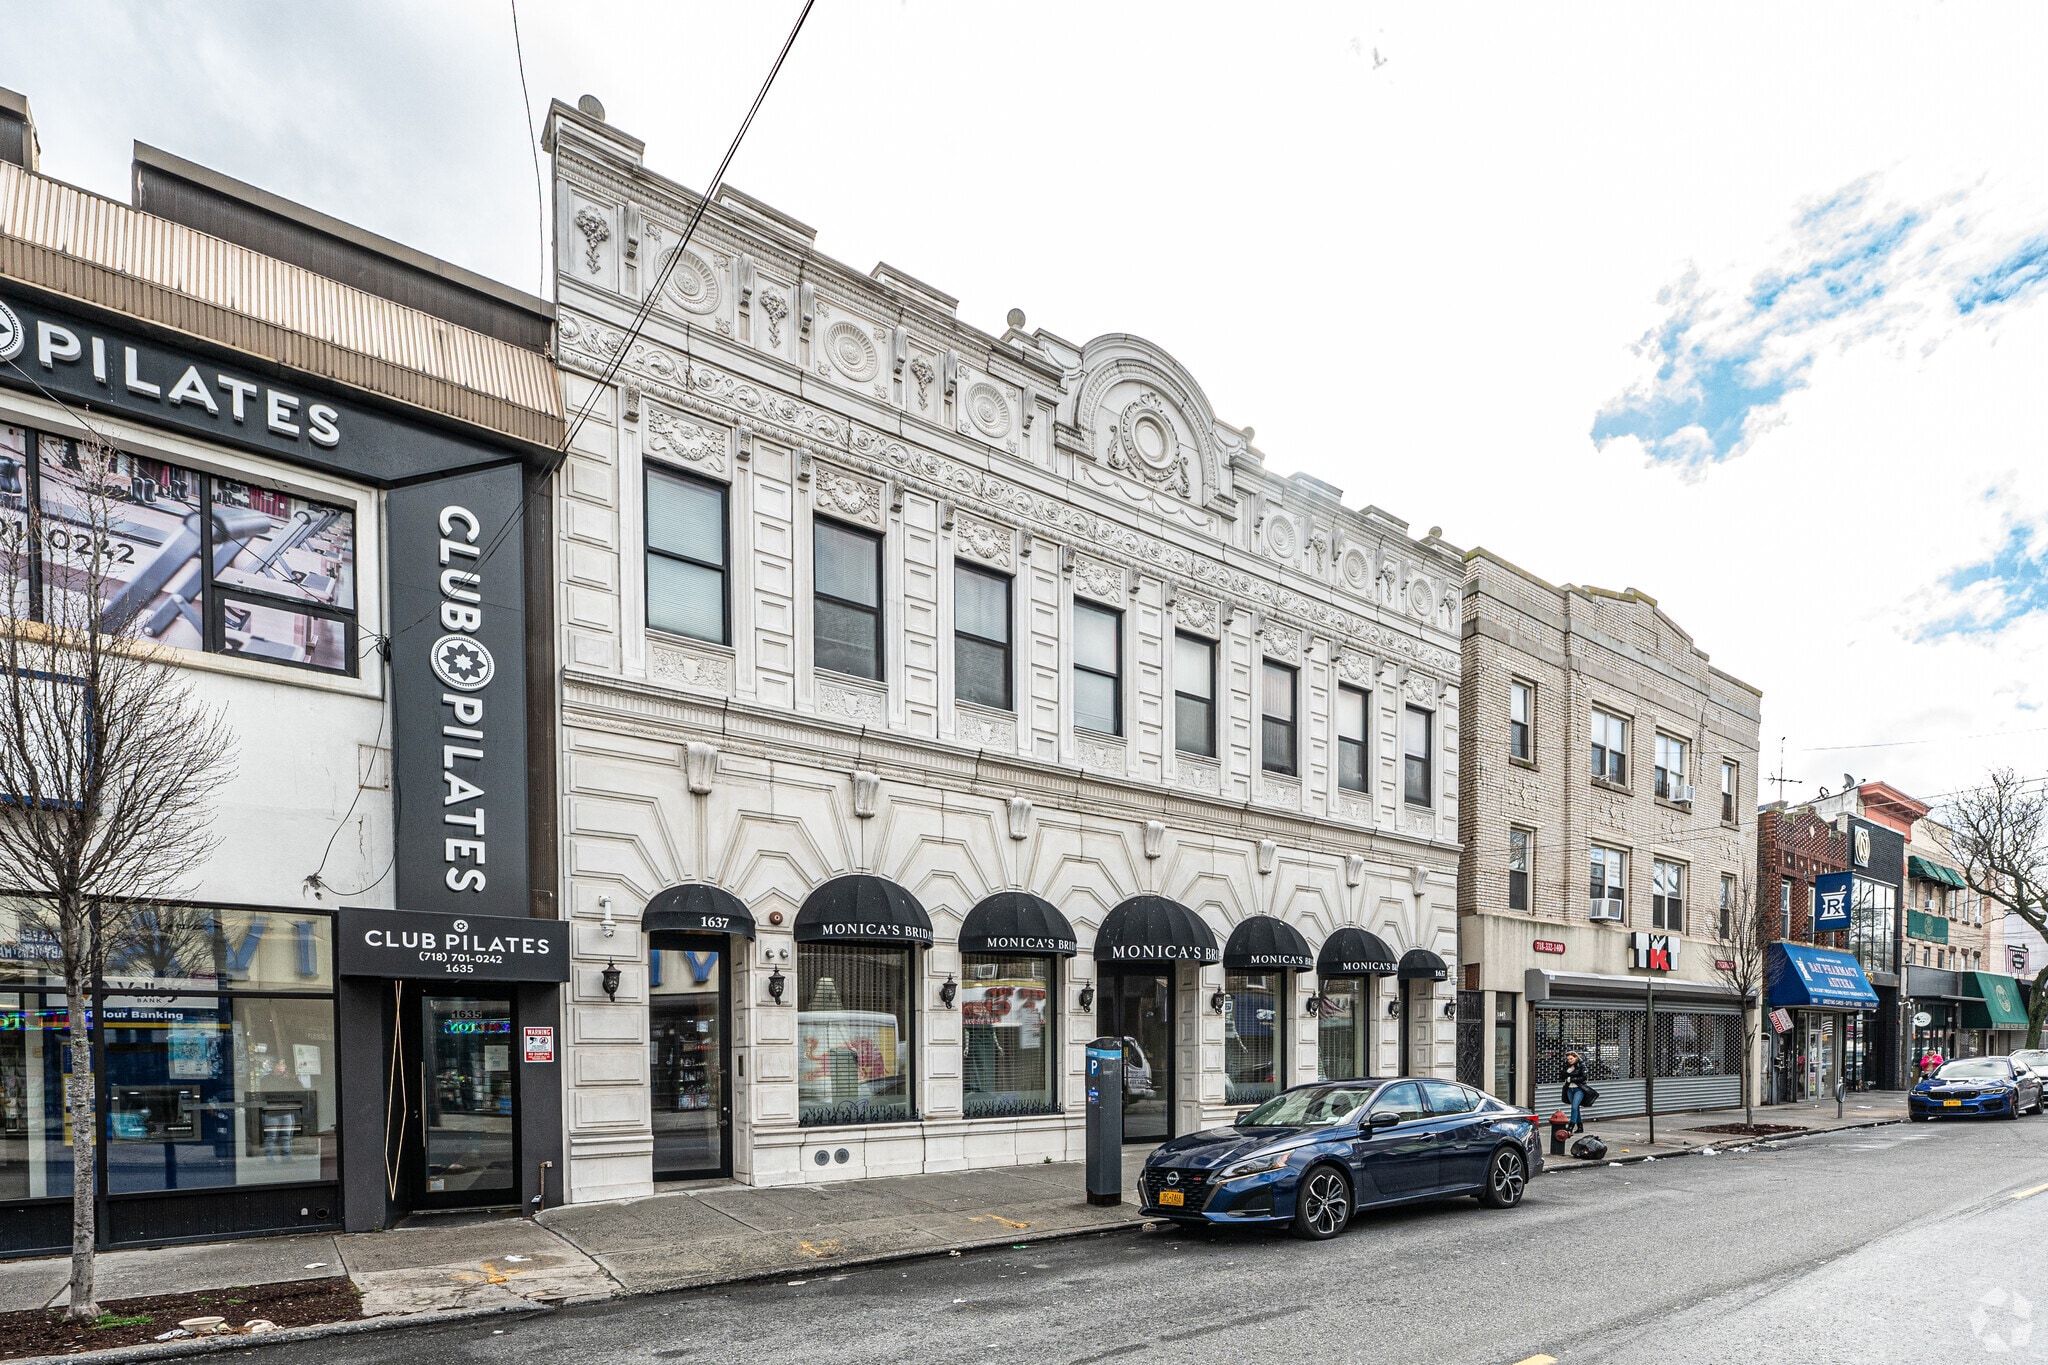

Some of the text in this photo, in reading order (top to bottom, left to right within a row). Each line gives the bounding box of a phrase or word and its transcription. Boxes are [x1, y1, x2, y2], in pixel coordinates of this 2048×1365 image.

[36, 320, 340, 447] PILATES
[438, 505, 487, 892] CLUB PILATES
[701, 916, 729, 929] 1637
[822, 923, 900, 936] MONICA'S
[364, 929, 550, 955] CLUB PILATES
[987, 937, 1077, 951] MONICA'S BRID
[1536, 942, 1563, 952] 718-332-1400
[418, 951, 503, 964] (718) 701-0242
[1112, 945, 1220, 961] MONICA'S BRI
[1251, 954, 1303, 965] MONICA'S
[445, 963, 474, 973] 1635
[1343, 961, 1391, 970] MONICA'S
[1807, 962, 1859, 978] BAY PHARMACY
[117, 981, 182, 1003] Vlly
[131, 1011, 184, 1020] Banking
[451, 1010, 482, 1018] 1635
[1091, 1059, 1098, 1075] P
